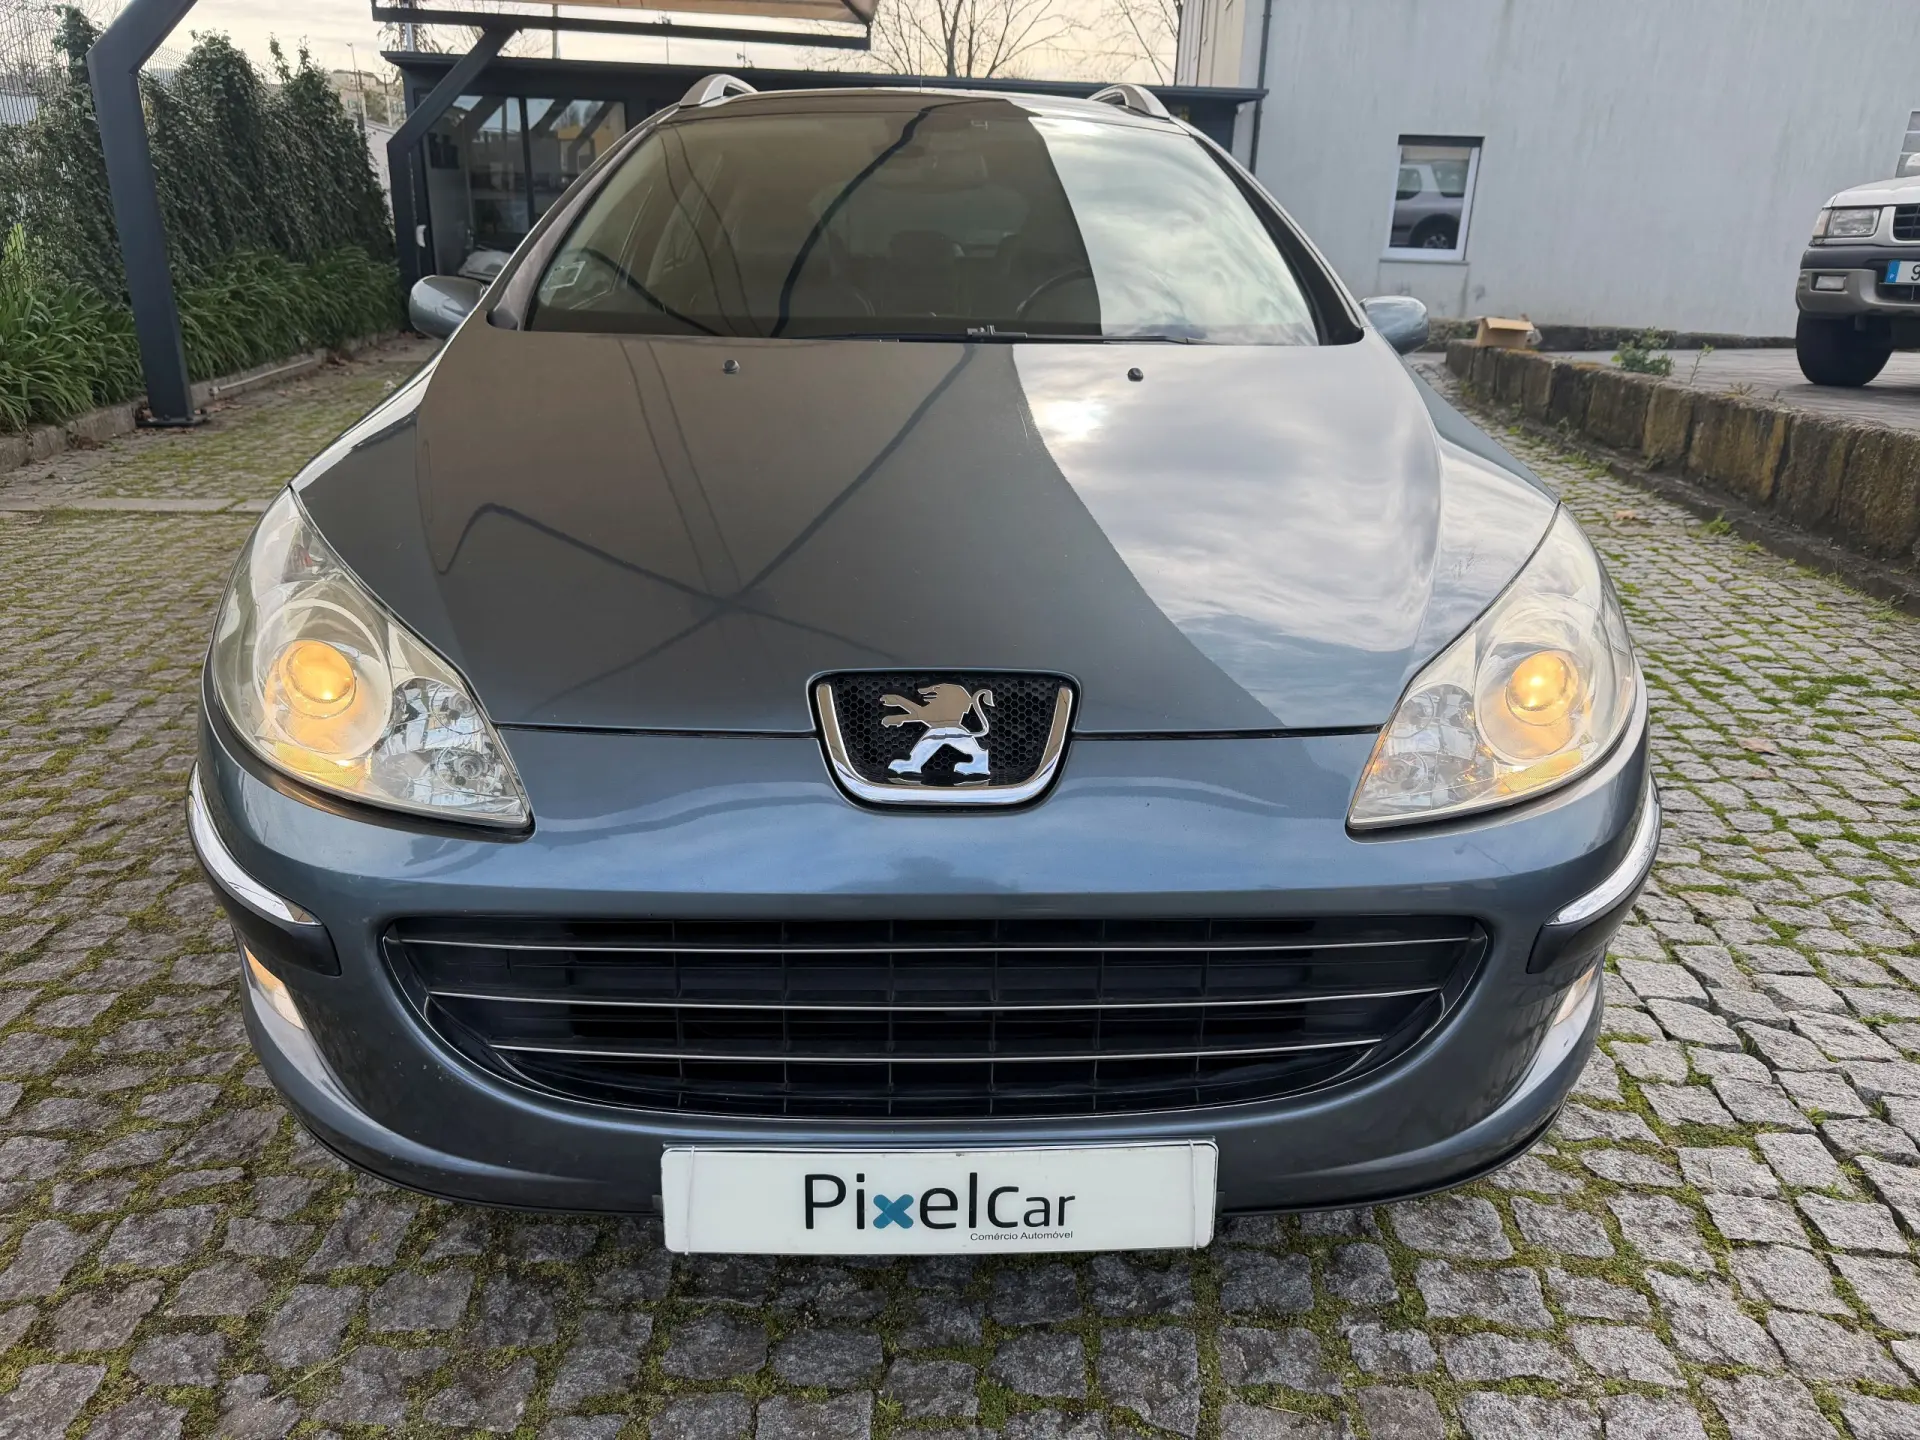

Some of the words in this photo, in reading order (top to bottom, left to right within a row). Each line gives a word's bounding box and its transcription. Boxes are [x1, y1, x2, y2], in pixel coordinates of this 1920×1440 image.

[804, 1171, 1076, 1230] PixelCar
[970, 1232, 1018, 1241] Comércio
[1020, 1230, 1073, 1240] Automóvel
